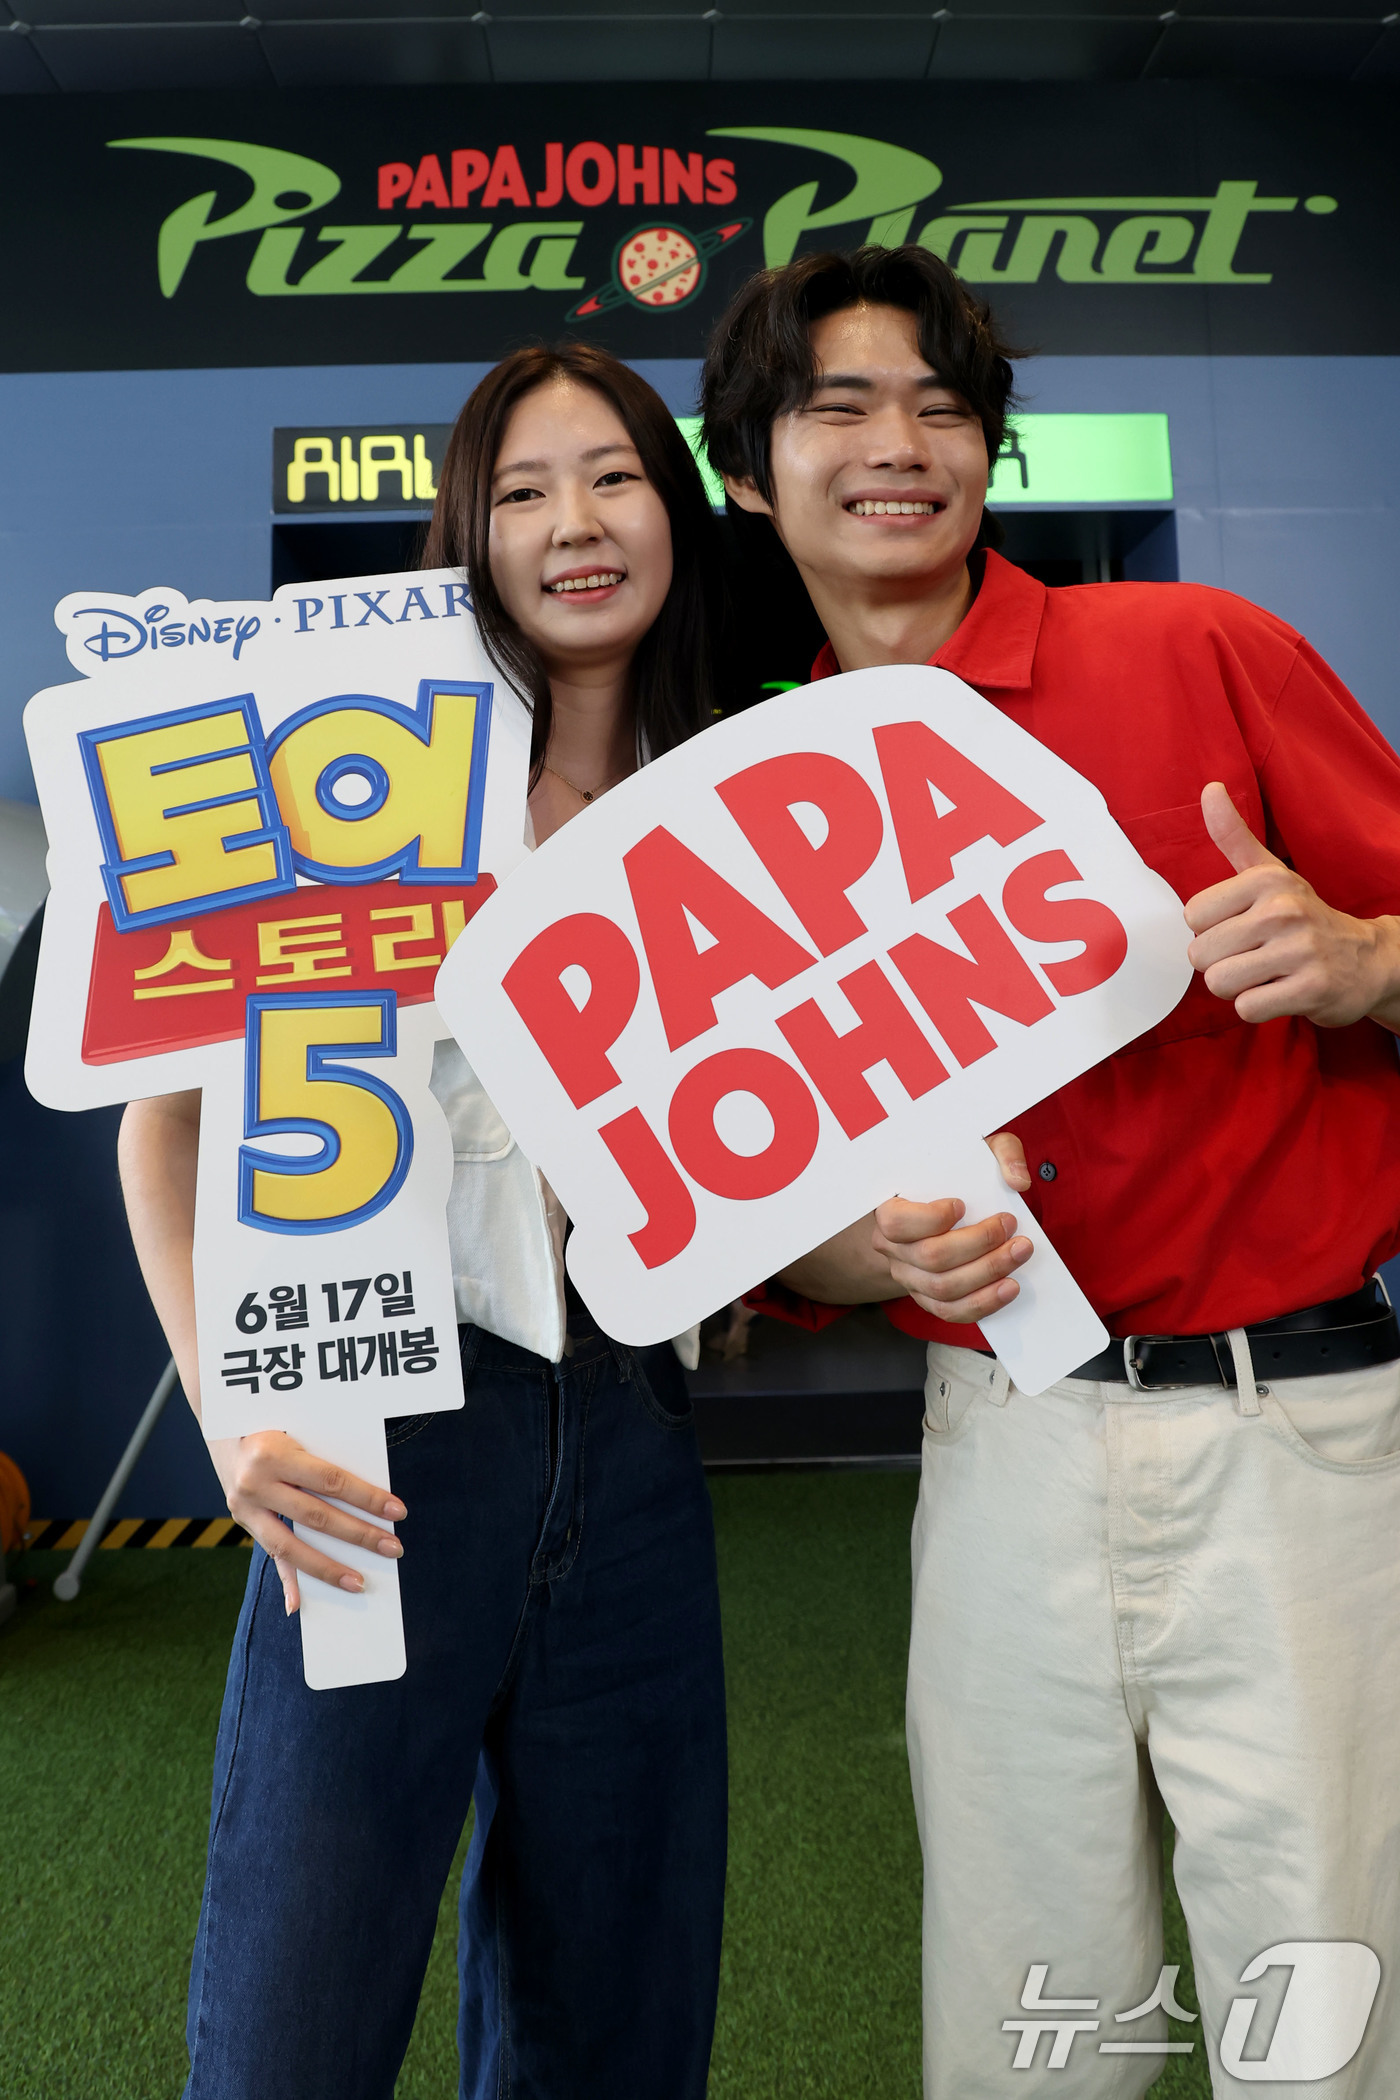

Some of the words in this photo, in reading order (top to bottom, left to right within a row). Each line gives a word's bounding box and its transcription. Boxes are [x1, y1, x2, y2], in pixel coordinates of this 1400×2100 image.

[105, 136, 586, 299] Pizza
[705, 126, 1337, 285] Planet
[377, 145, 532, 210] PAPA
[536, 141, 738, 207] JOHNS
[292, 582, 476, 634] PIXAR
[76, 678, 495, 935] 토이
[133, 900, 468, 1001] 스토리
[501, 720, 1046, 1111] PAPA
[237, 988, 415, 1237] 5
[597, 848, 1128, 1271] JOHNS
[220, 1343, 306, 1395] 극장
[318, 1326, 440, 1383] 대개봉
[234, 1283, 311, 1335] 6월
[321, 1270, 416, 1323] 17일
